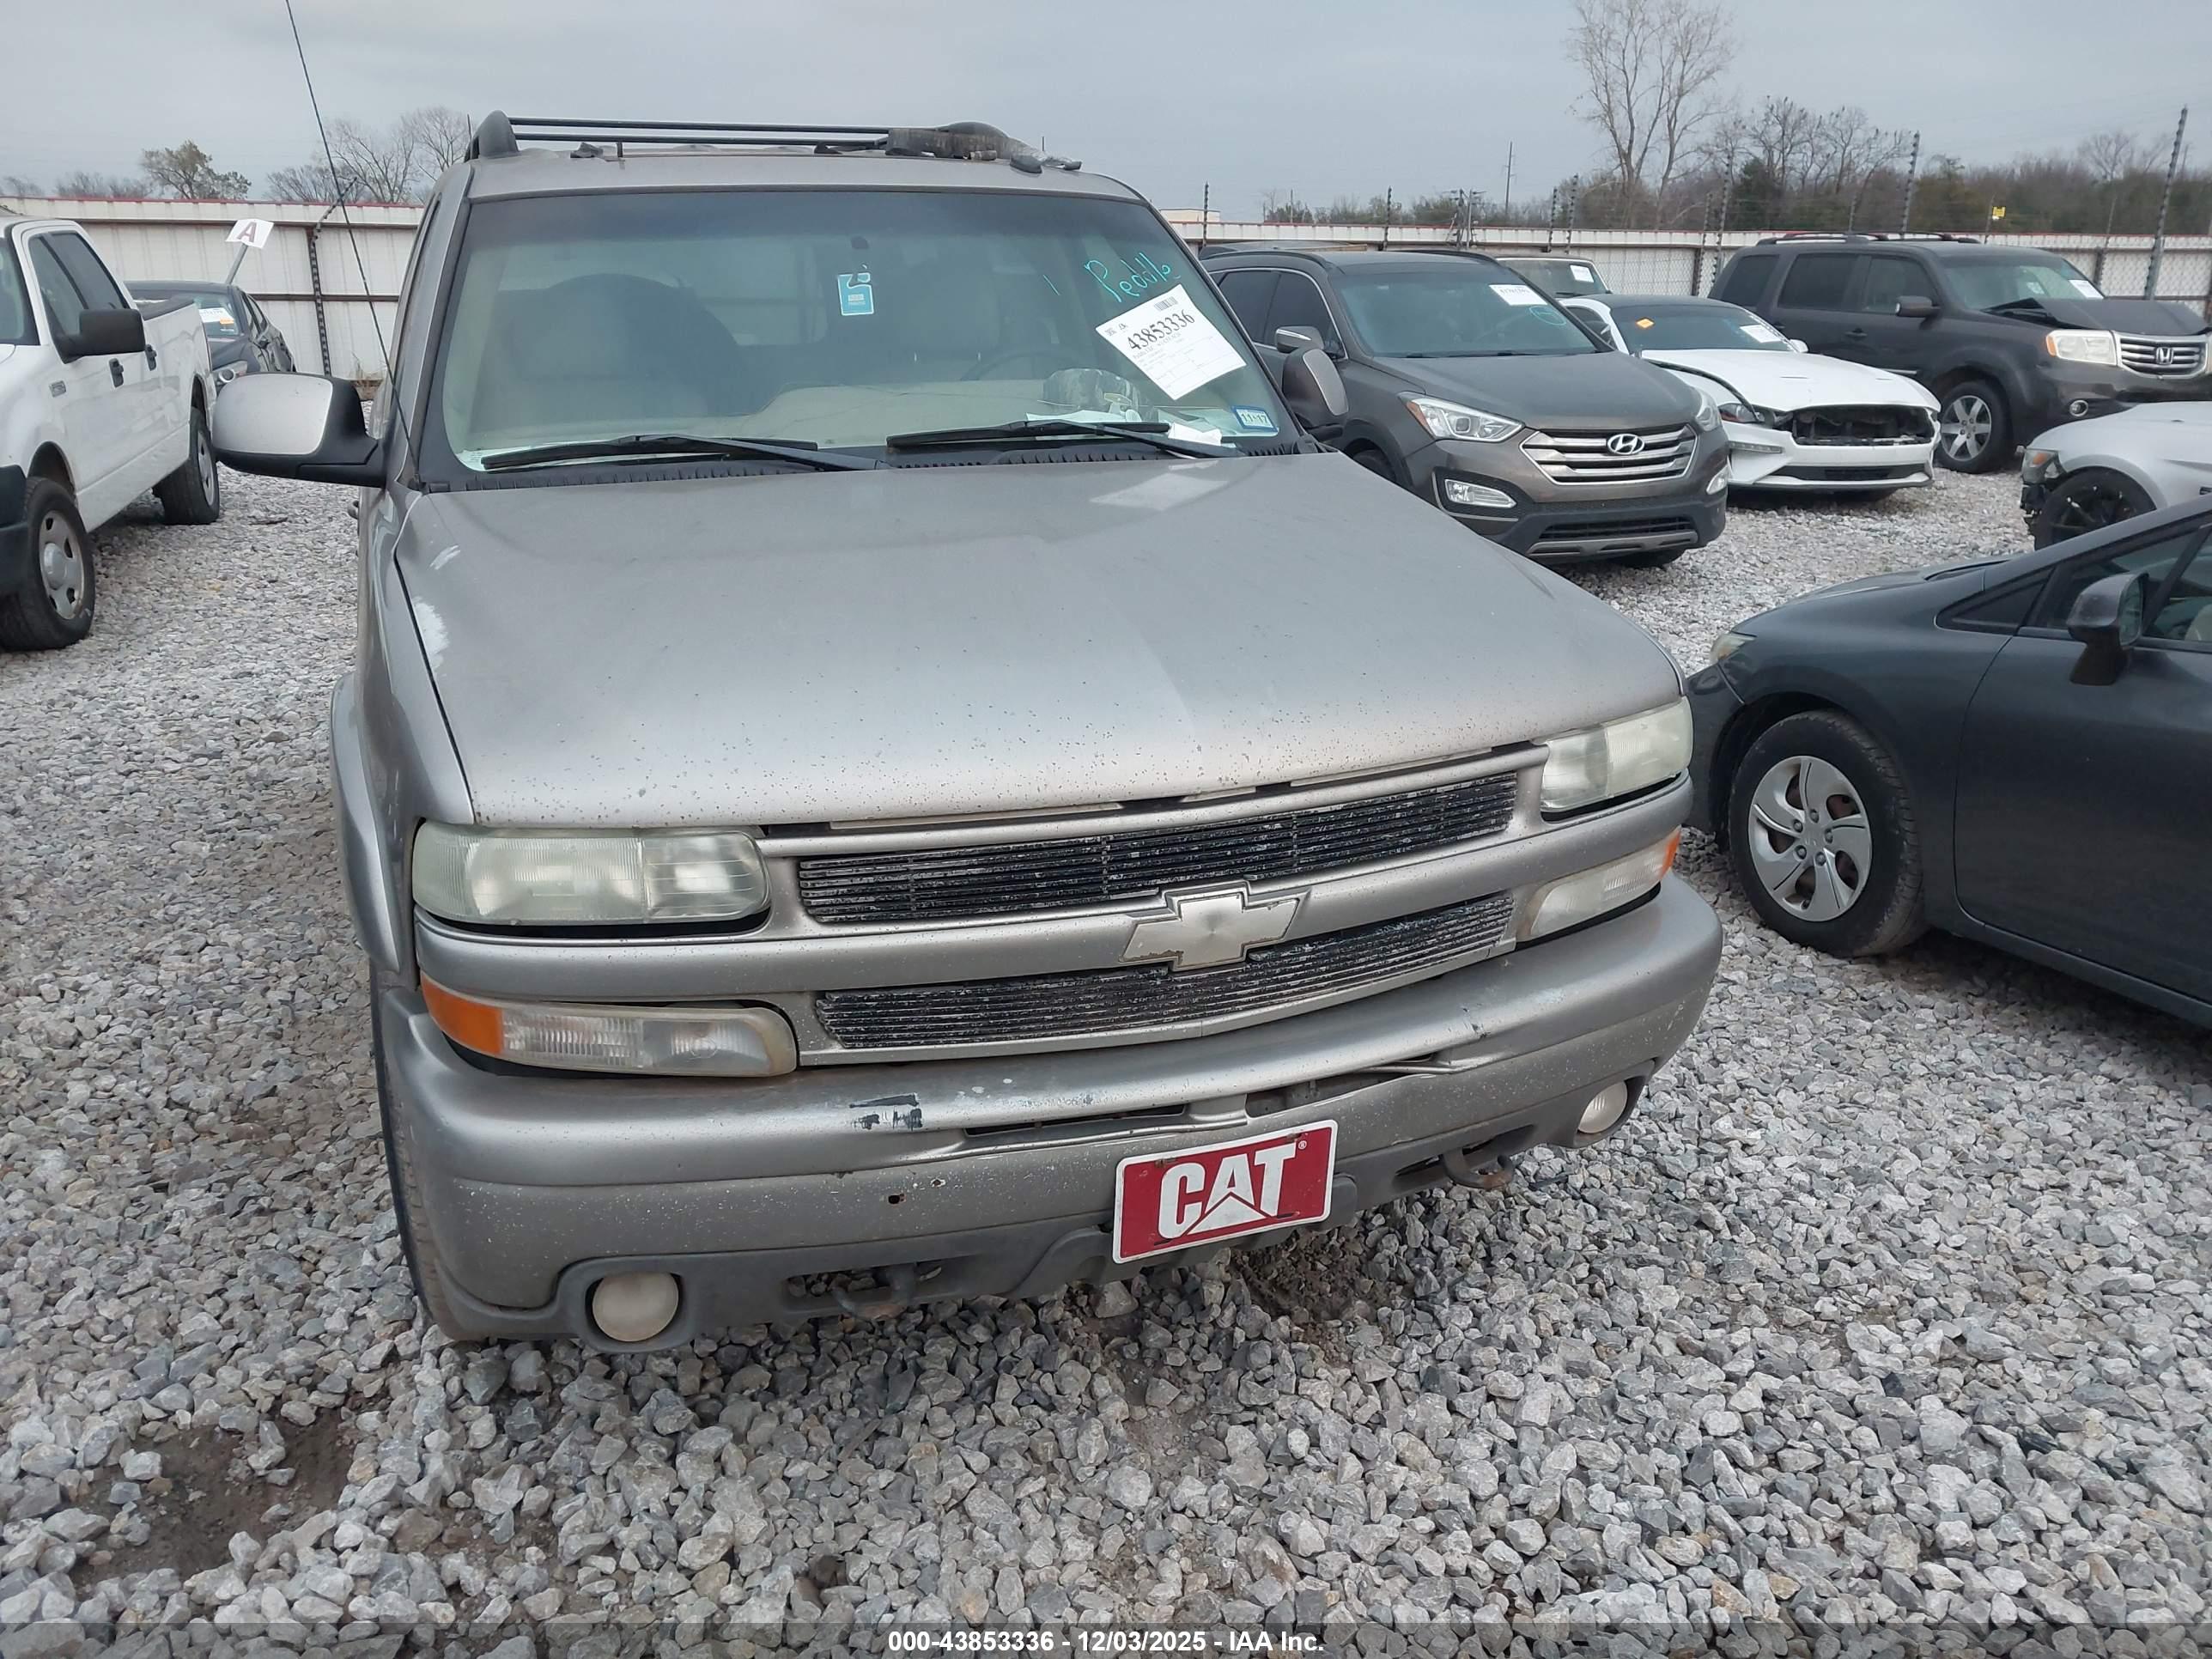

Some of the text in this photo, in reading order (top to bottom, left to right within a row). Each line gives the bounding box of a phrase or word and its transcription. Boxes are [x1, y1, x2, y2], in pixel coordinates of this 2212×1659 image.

[237, 222, 257, 242] A
[1127, 308, 1195, 350] 43853336
[1158, 1141, 1297, 1239] CAT
